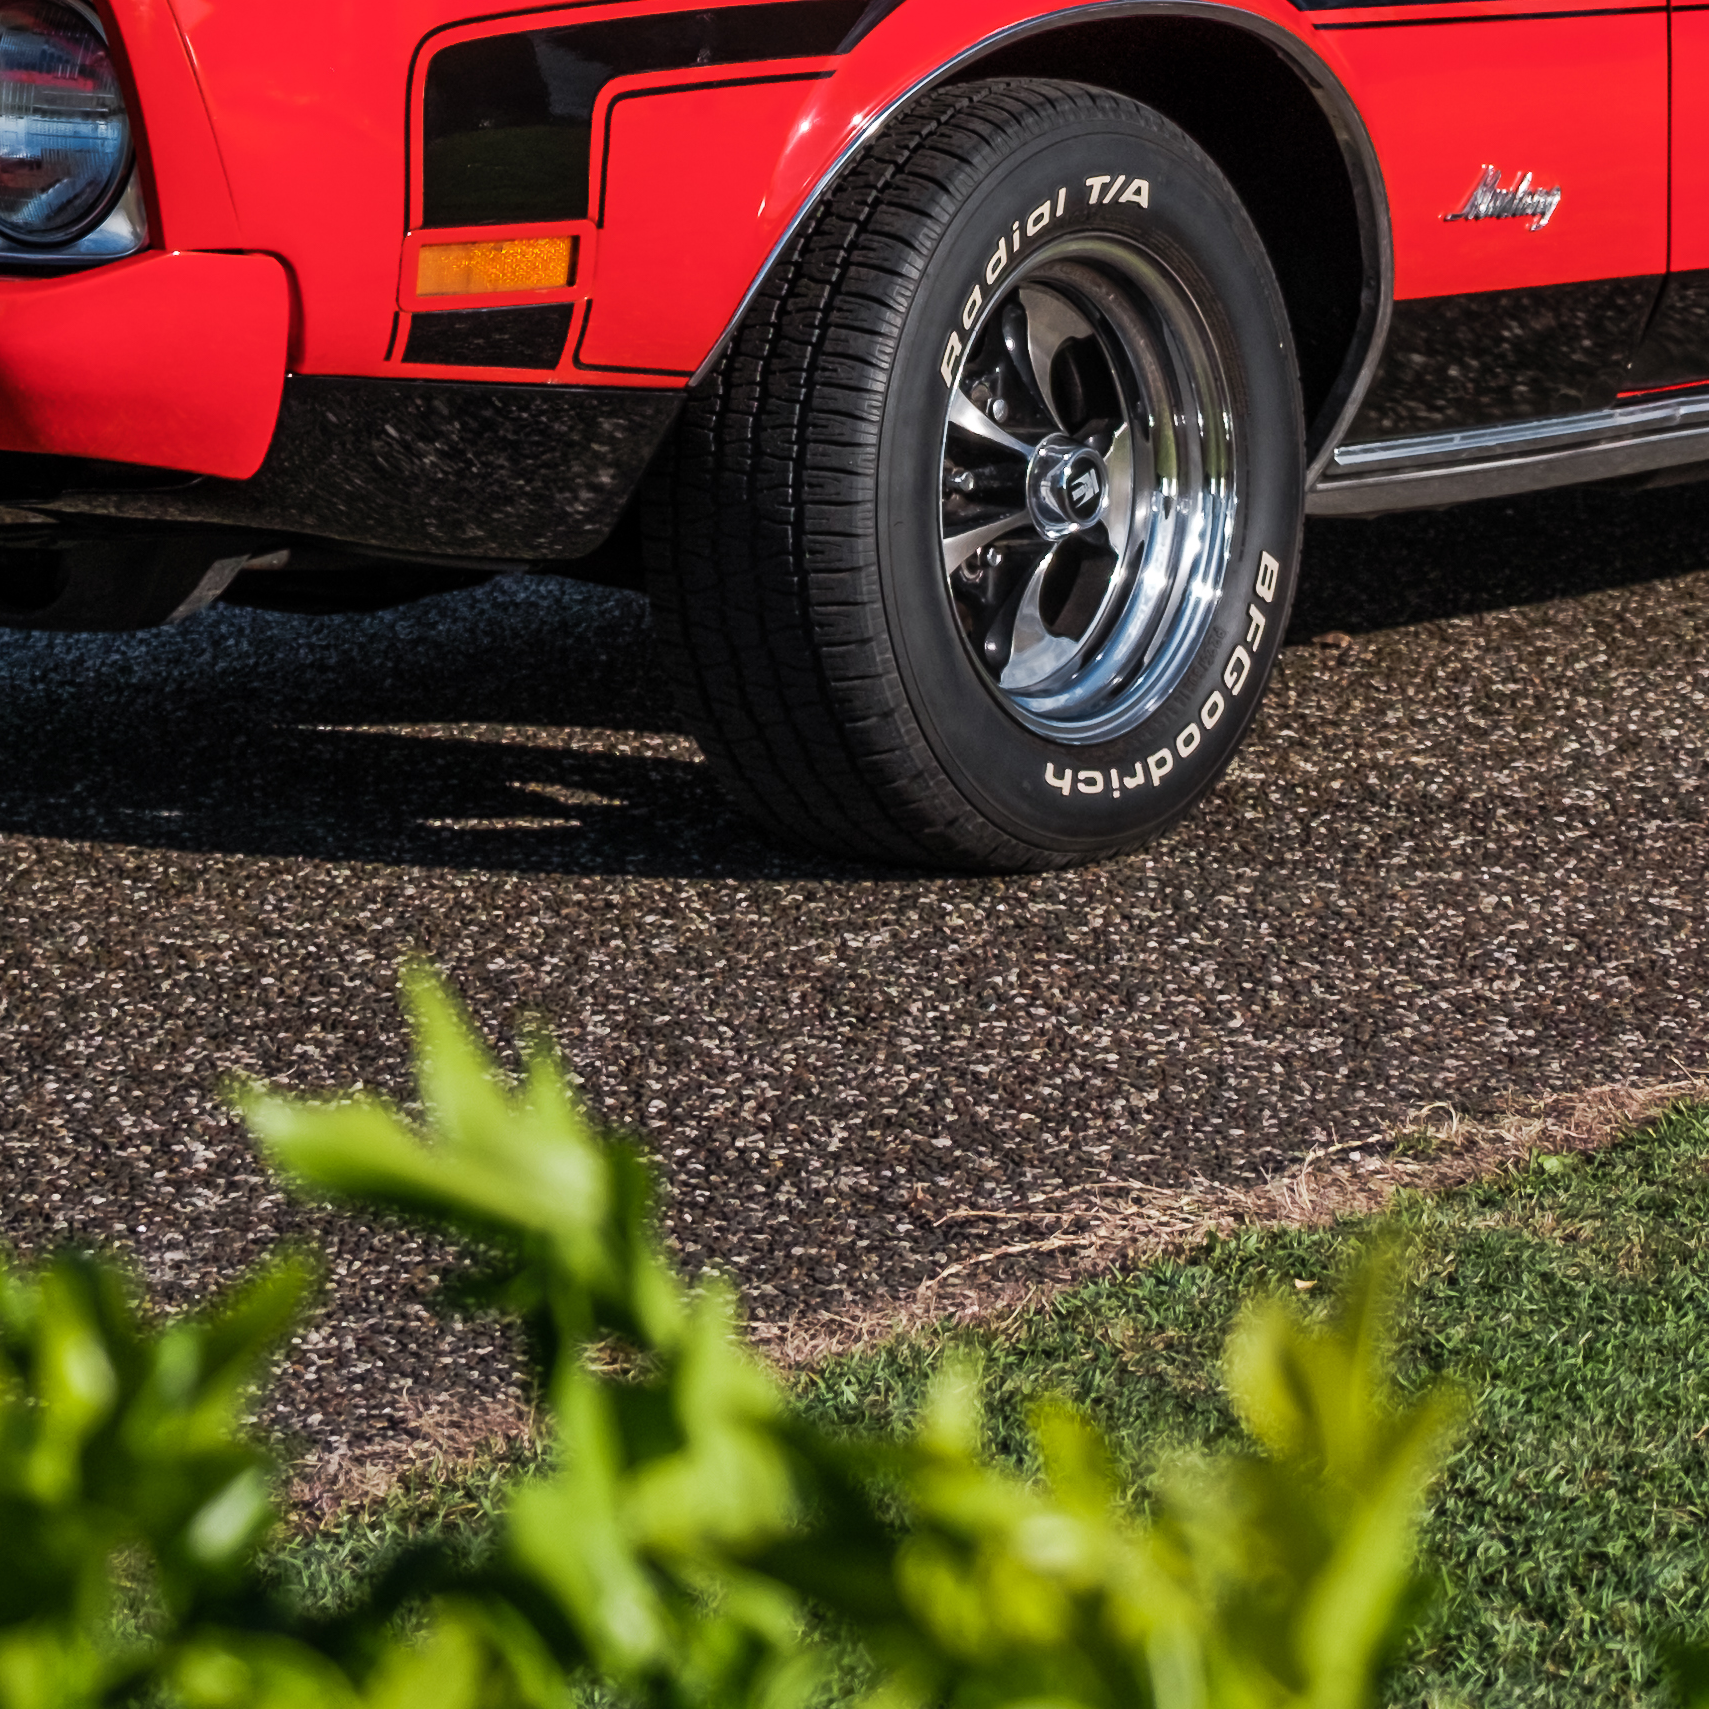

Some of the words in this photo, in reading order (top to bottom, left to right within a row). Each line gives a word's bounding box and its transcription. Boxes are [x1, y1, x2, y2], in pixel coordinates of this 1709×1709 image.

[940, 186, 1068, 389] Radial
[1085, 173, 1152, 209] T/A
[1043, 549, 1281, 800] BFGoodrich
